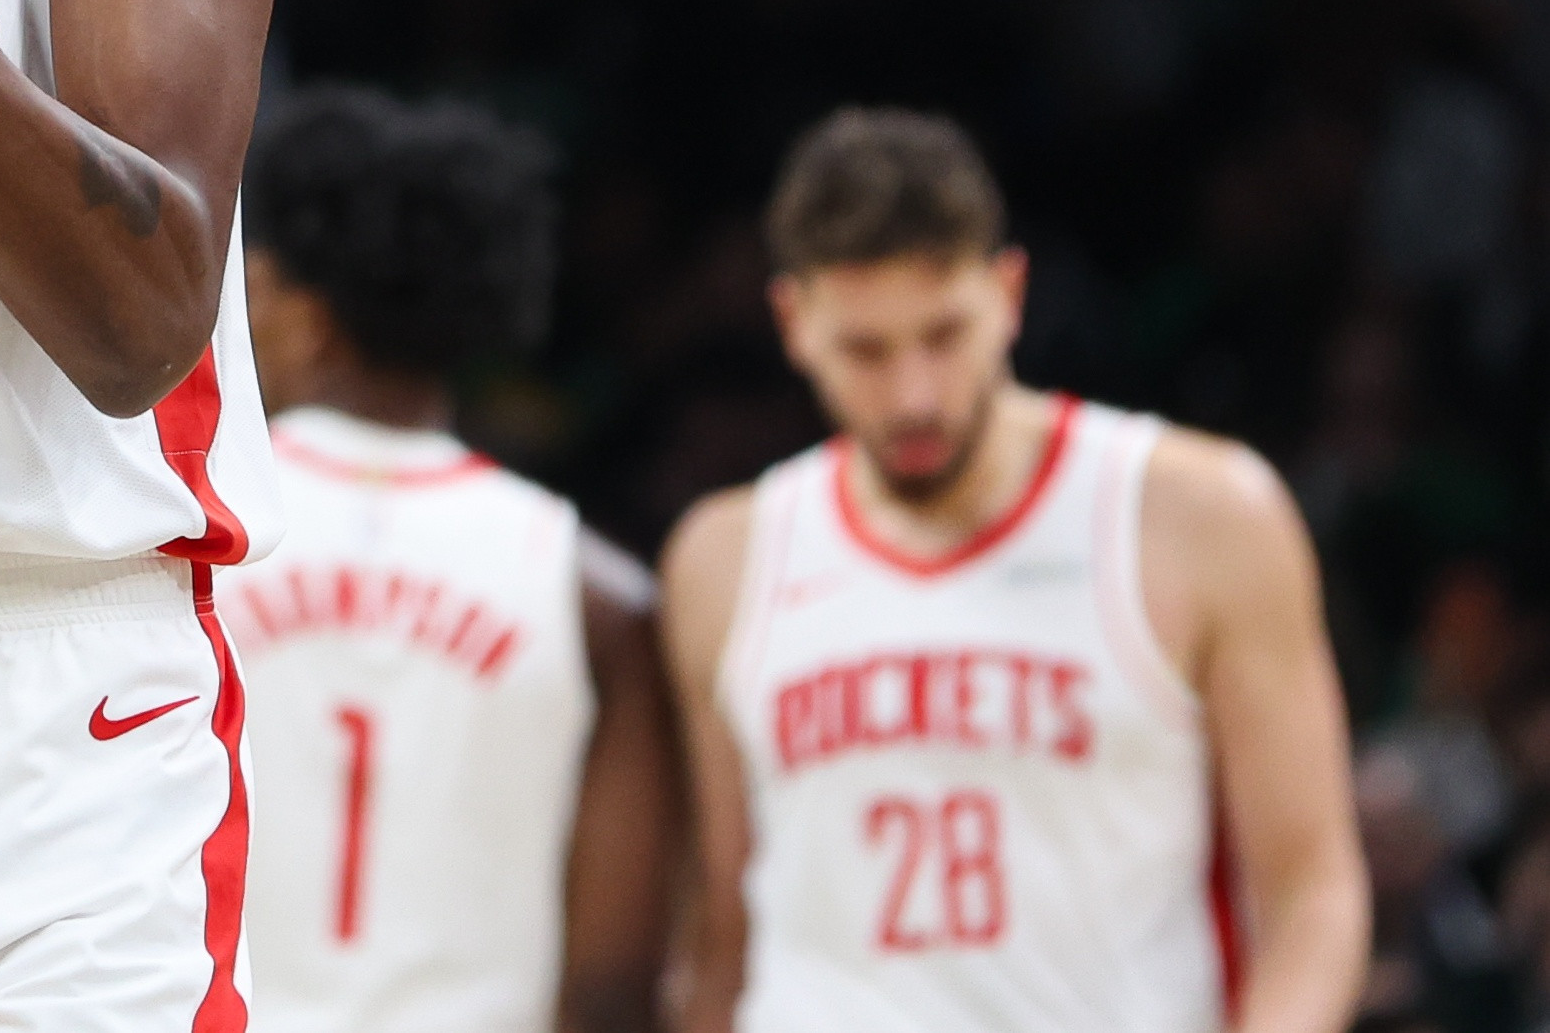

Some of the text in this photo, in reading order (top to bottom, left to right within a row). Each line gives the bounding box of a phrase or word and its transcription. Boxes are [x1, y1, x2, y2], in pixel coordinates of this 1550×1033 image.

[770, 647, 1096, 775] ROCKETS
[334, 703, 372, 947] 1
[862, 789, 1008, 951] 28
